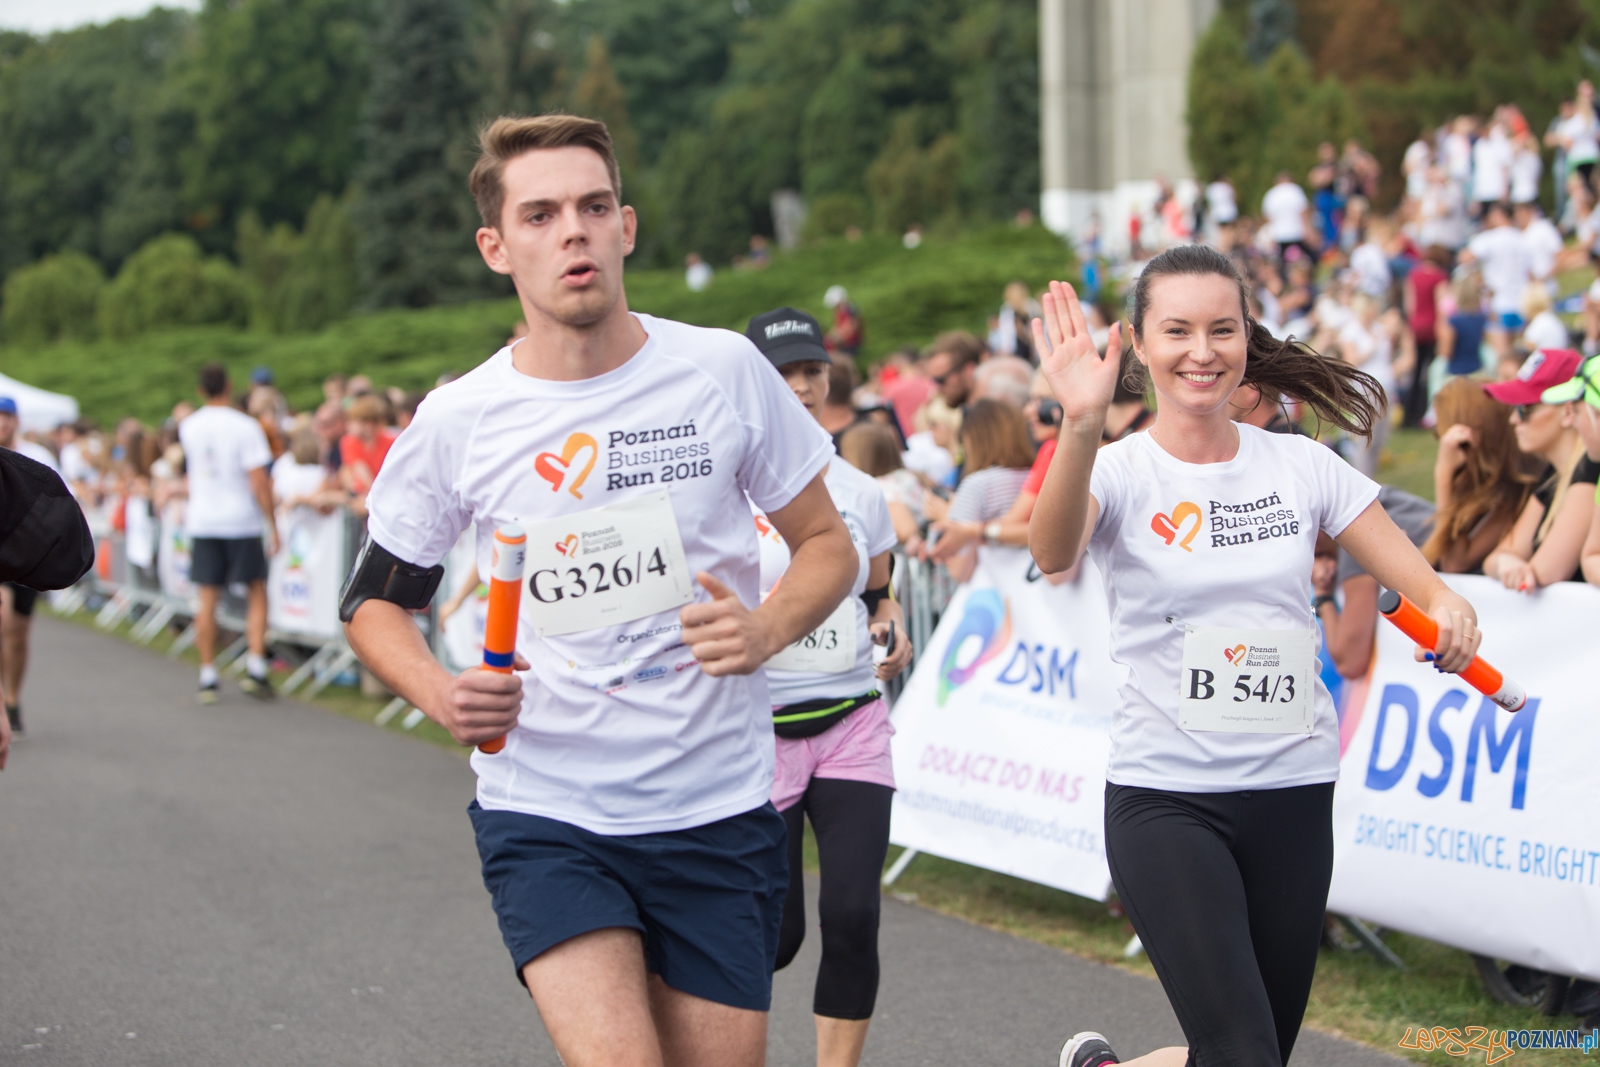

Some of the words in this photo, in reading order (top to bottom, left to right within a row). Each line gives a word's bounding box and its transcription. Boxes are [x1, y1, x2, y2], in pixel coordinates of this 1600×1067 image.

[608, 418, 697, 448] Poznań
[607, 441, 711, 470] Business
[606, 471, 655, 491] Run
[660, 459, 713, 483] 2016
[1209, 491, 1282, 515] Poznań
[1210, 509, 1295, 533] Business
[1211, 531, 1254, 548] Run
[1257, 521, 1299, 541] 2016
[529, 546, 667, 604] G326/4
[1247, 653, 1281, 661] Business
[1248, 645, 1278, 654] Poznań
[996, 641, 1079, 699] DSM
[1186, 668, 1215, 700] B
[1233, 674, 1296, 703] 54/3
[1364, 683, 1542, 811] DSM
[998, 759, 1033, 791] DO
[1034, 768, 1084, 803] NAS
[1354, 814, 1421, 854] BRIGHT
[1424, 825, 1511, 871] SCIENCE.
